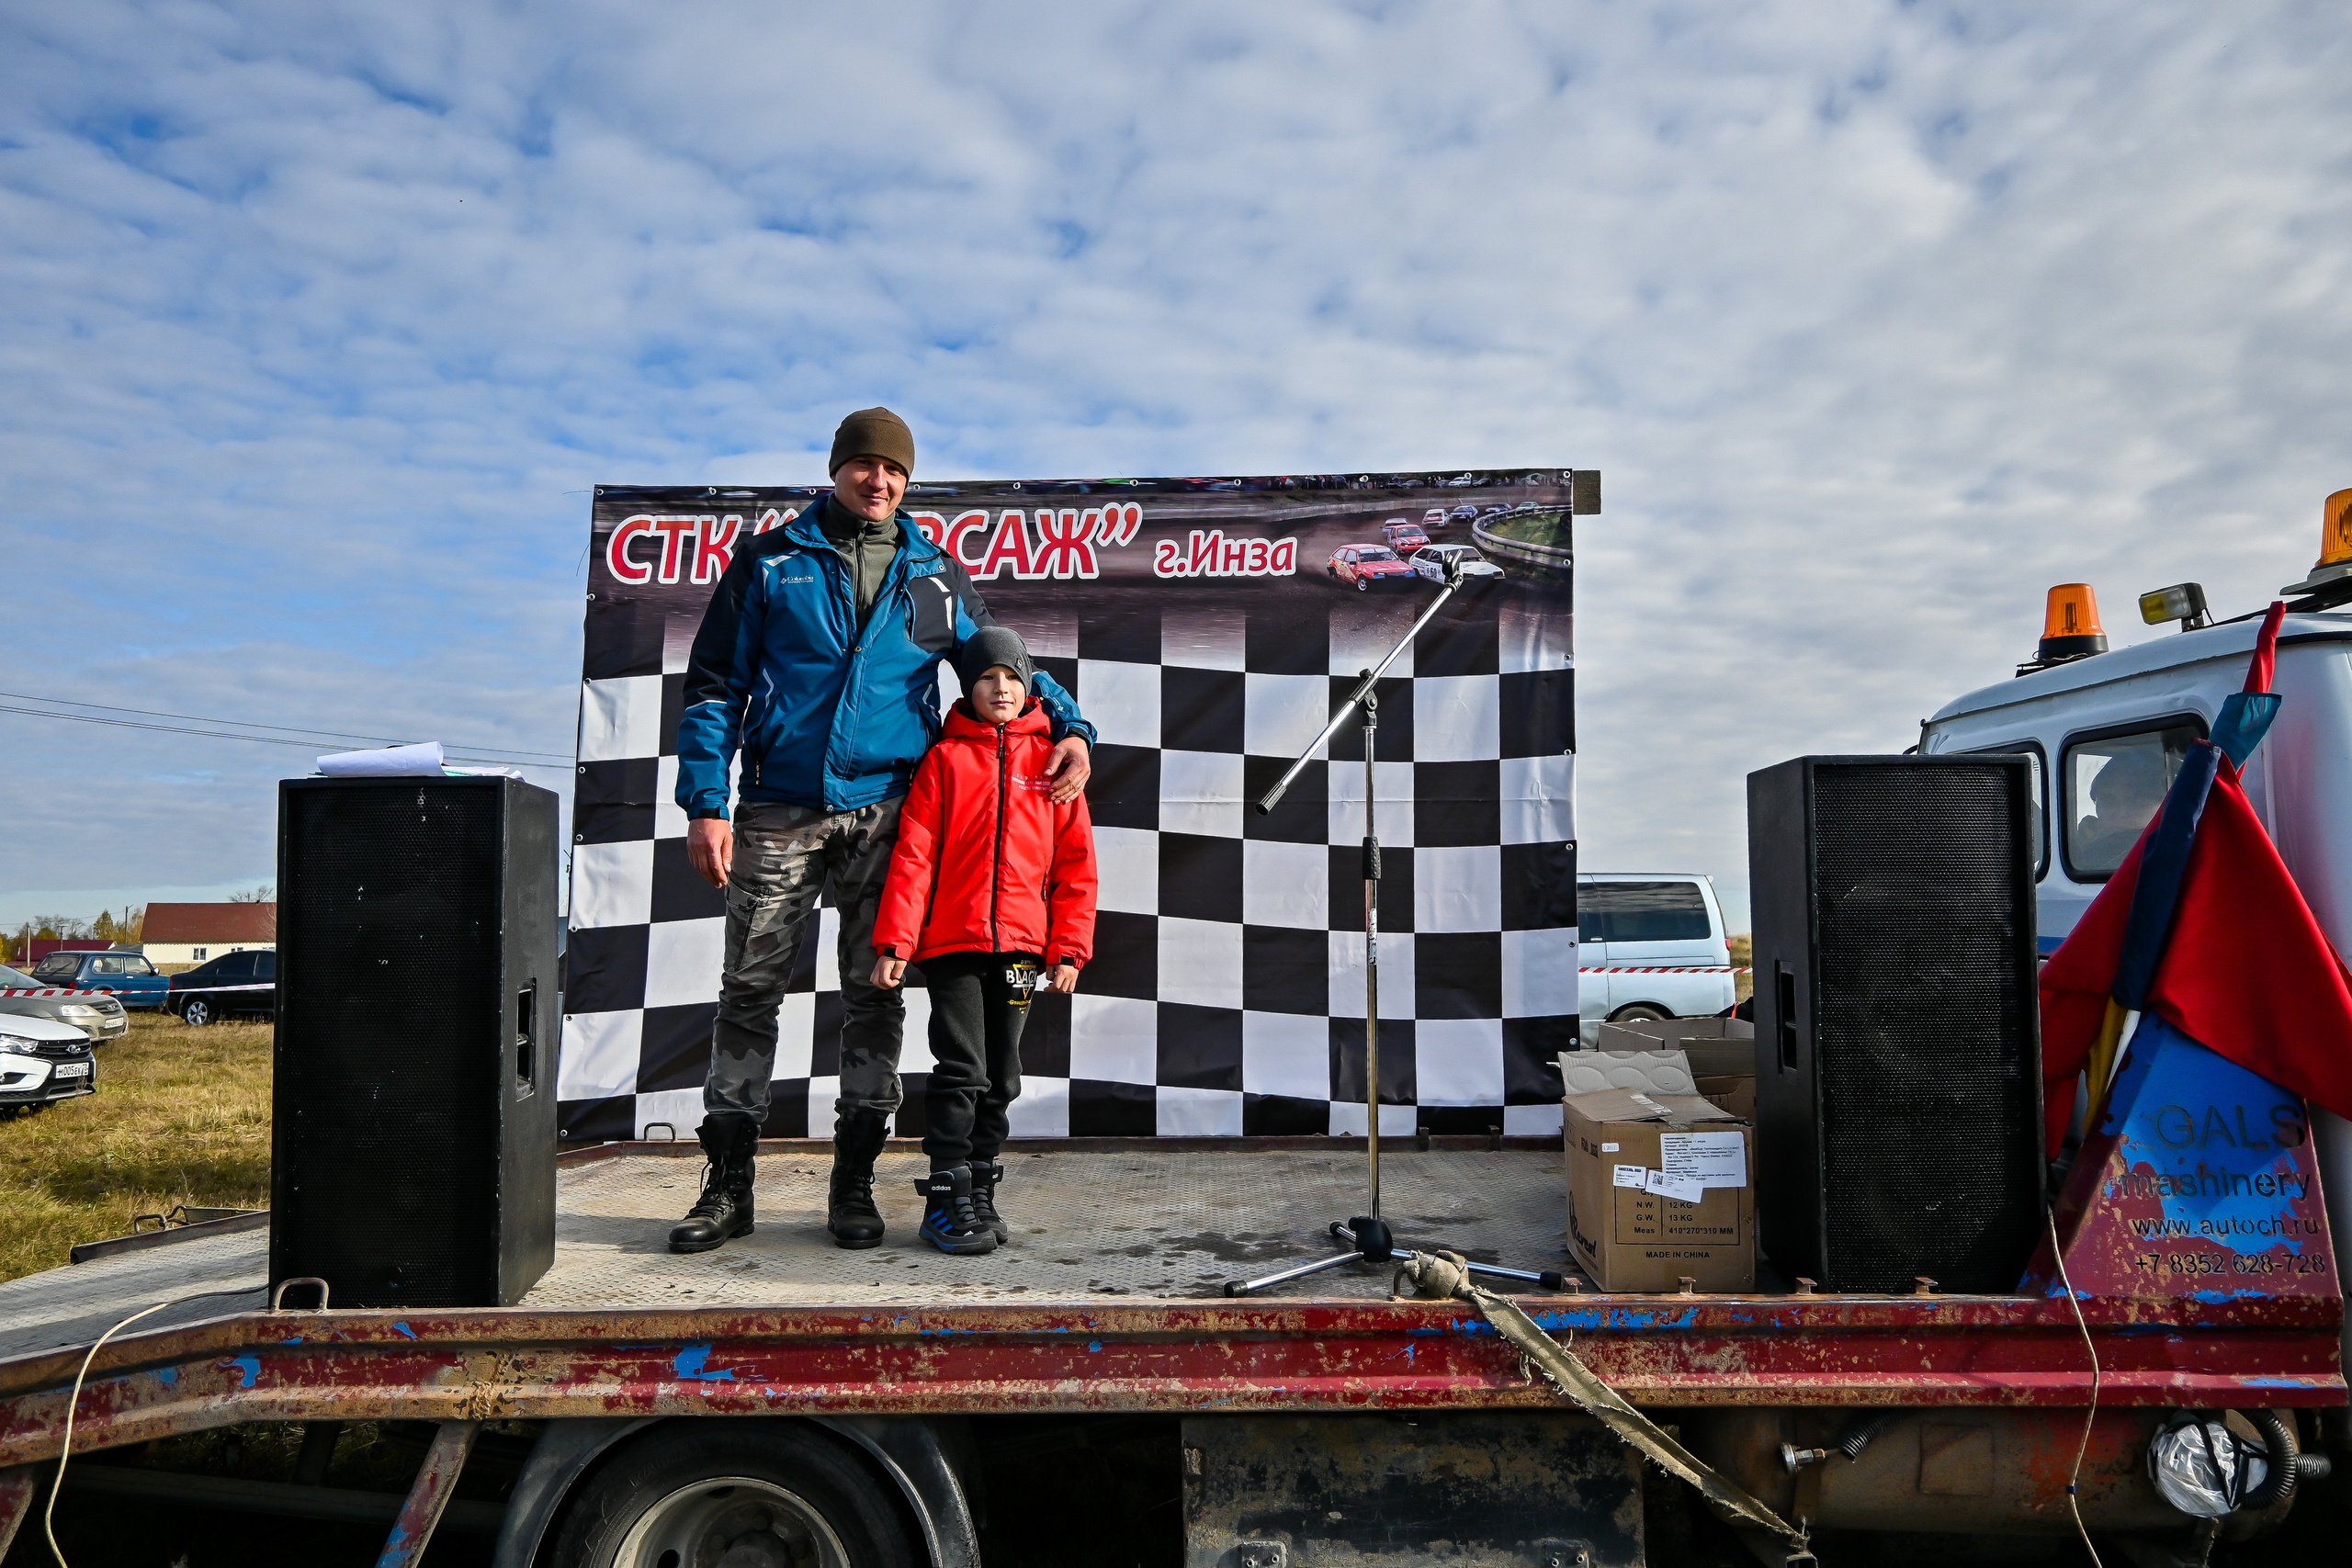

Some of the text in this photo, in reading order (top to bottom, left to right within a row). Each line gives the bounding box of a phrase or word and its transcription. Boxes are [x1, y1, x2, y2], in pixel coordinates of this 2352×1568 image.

[606, 514, 743, 585] СТК
[2154, 1104, 2307, 1148] GALS
[2120, 1166, 2311, 1201] mashinery
[2131, 1214, 2319, 1235] www.autoch.ru
[1645, 1250, 1710, 1258] MADE IN CHINA
[2134, 1254, 2326, 1274] +7 8352 628-728
